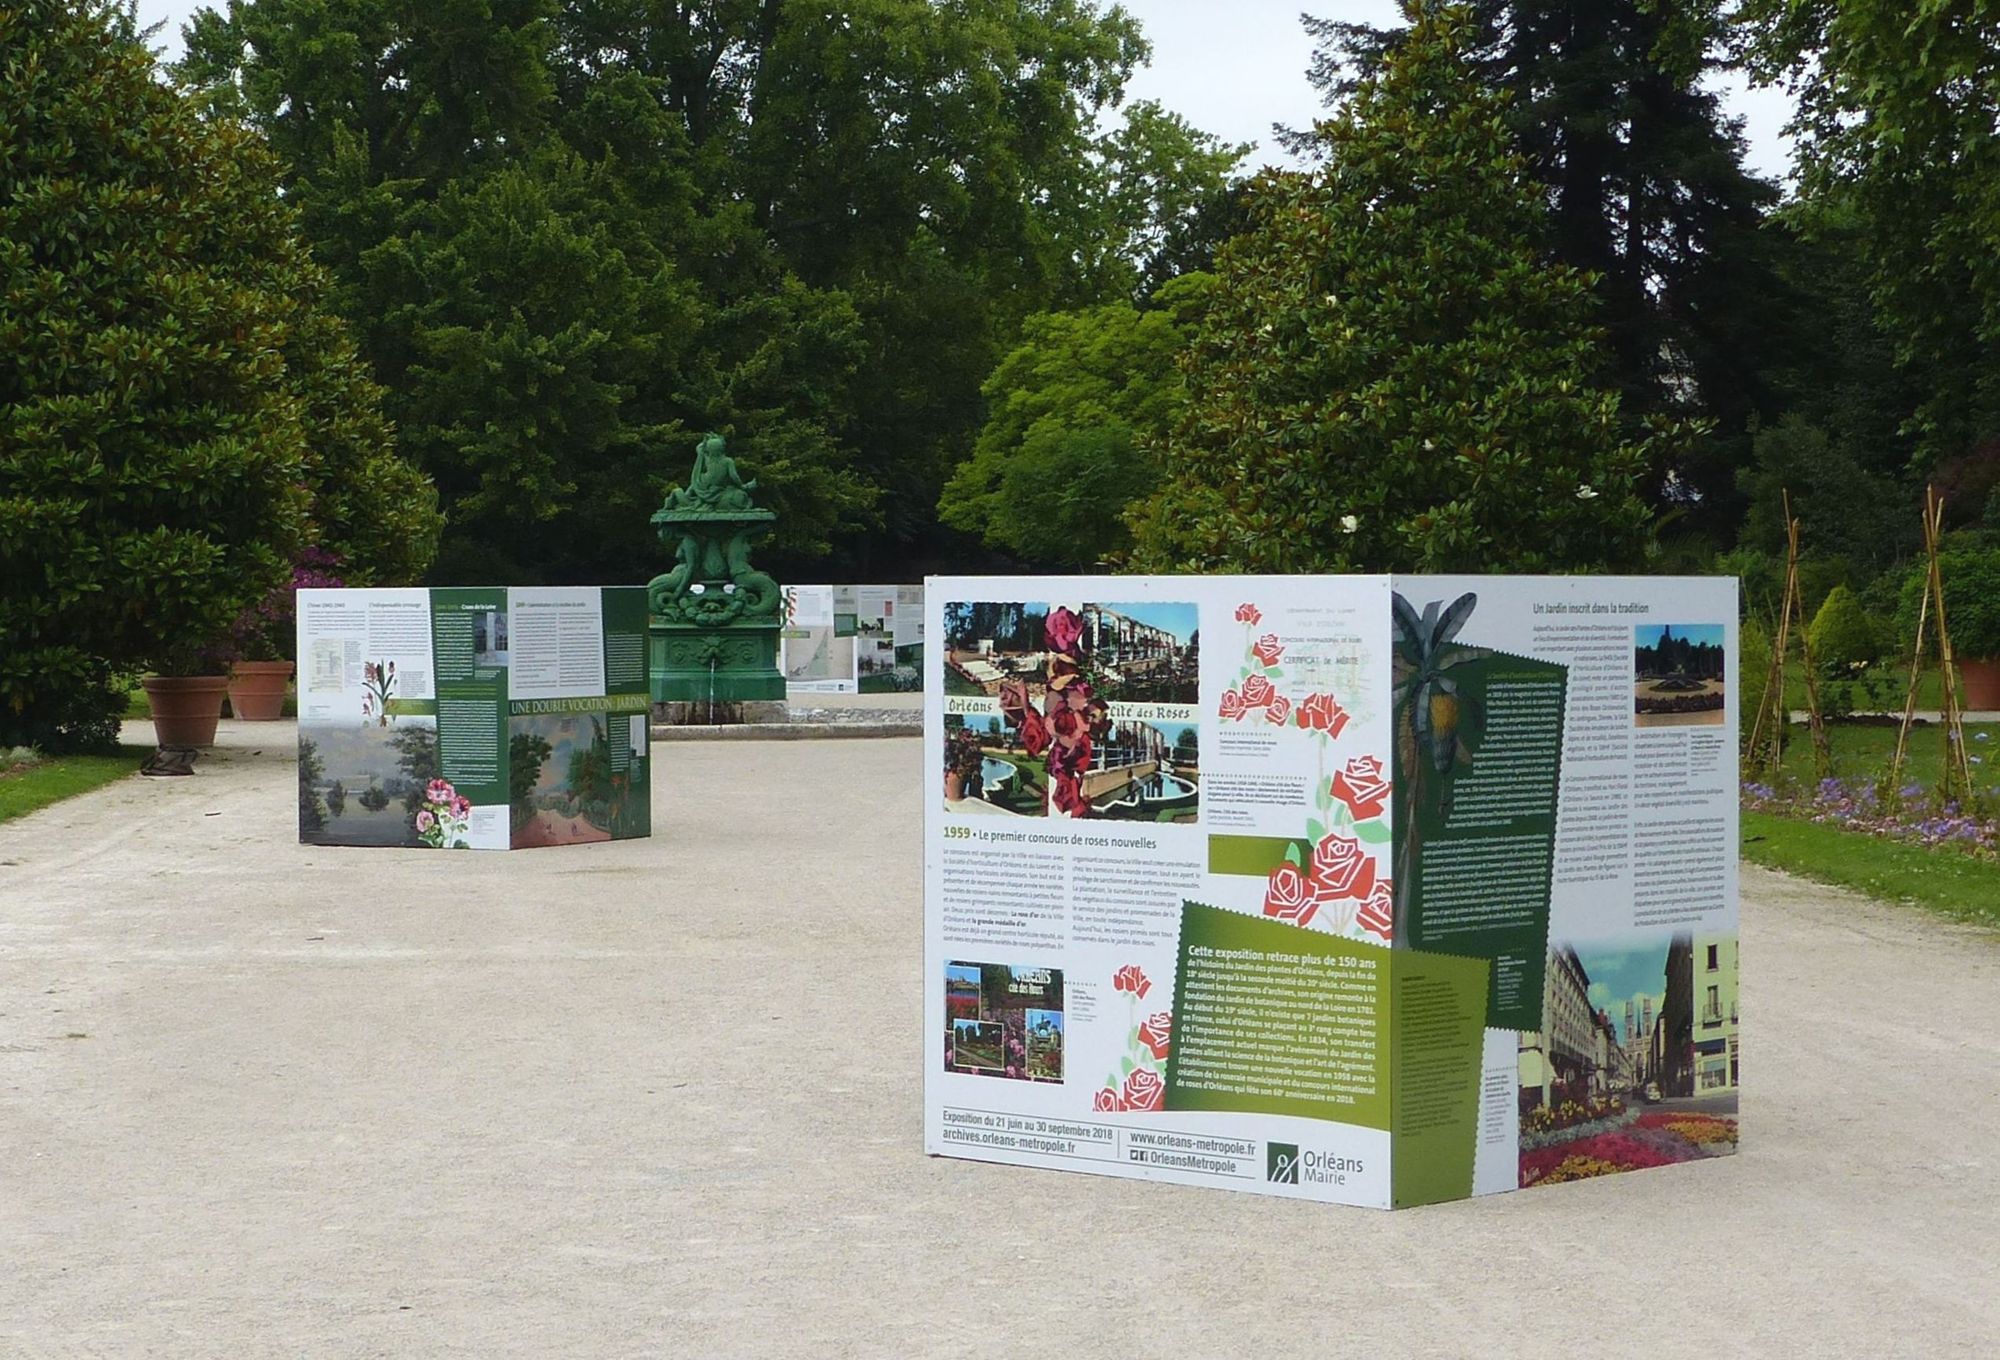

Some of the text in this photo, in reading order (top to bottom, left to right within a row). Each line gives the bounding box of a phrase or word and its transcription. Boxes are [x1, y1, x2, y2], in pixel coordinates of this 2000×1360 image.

[1533, 602, 1649, 614] Un Jardin inscrit dans la tradition
[512, 701, 530, 714] UNE
[532, 700, 566, 713] DOUBLE
[616, 696, 647, 710] JARDIN
[948, 700, 992, 713] Orléans
[1137, 708, 1154, 718] des
[1156, 708, 1191, 720] Roses
[944, 826, 1157, 850] 1959 Le premier concours de roses nouvelles
[1188, 945, 1377, 969] Cette exposition retrace plus de 150 ans
[943, 1111, 1113, 1139] Exposition du 21 juin au 30 septembre 2018
[942, 1126, 1076, 1155] archives.orleans-metropole.fr
[1130, 1130, 1255, 1158] www.orleans-metropole.fr
[1150, 1150, 1237, 1174] OrleansMetropole
[1304, 1149, 1364, 1174] Orléans
[1304, 1167, 1346, 1187] Mairie
